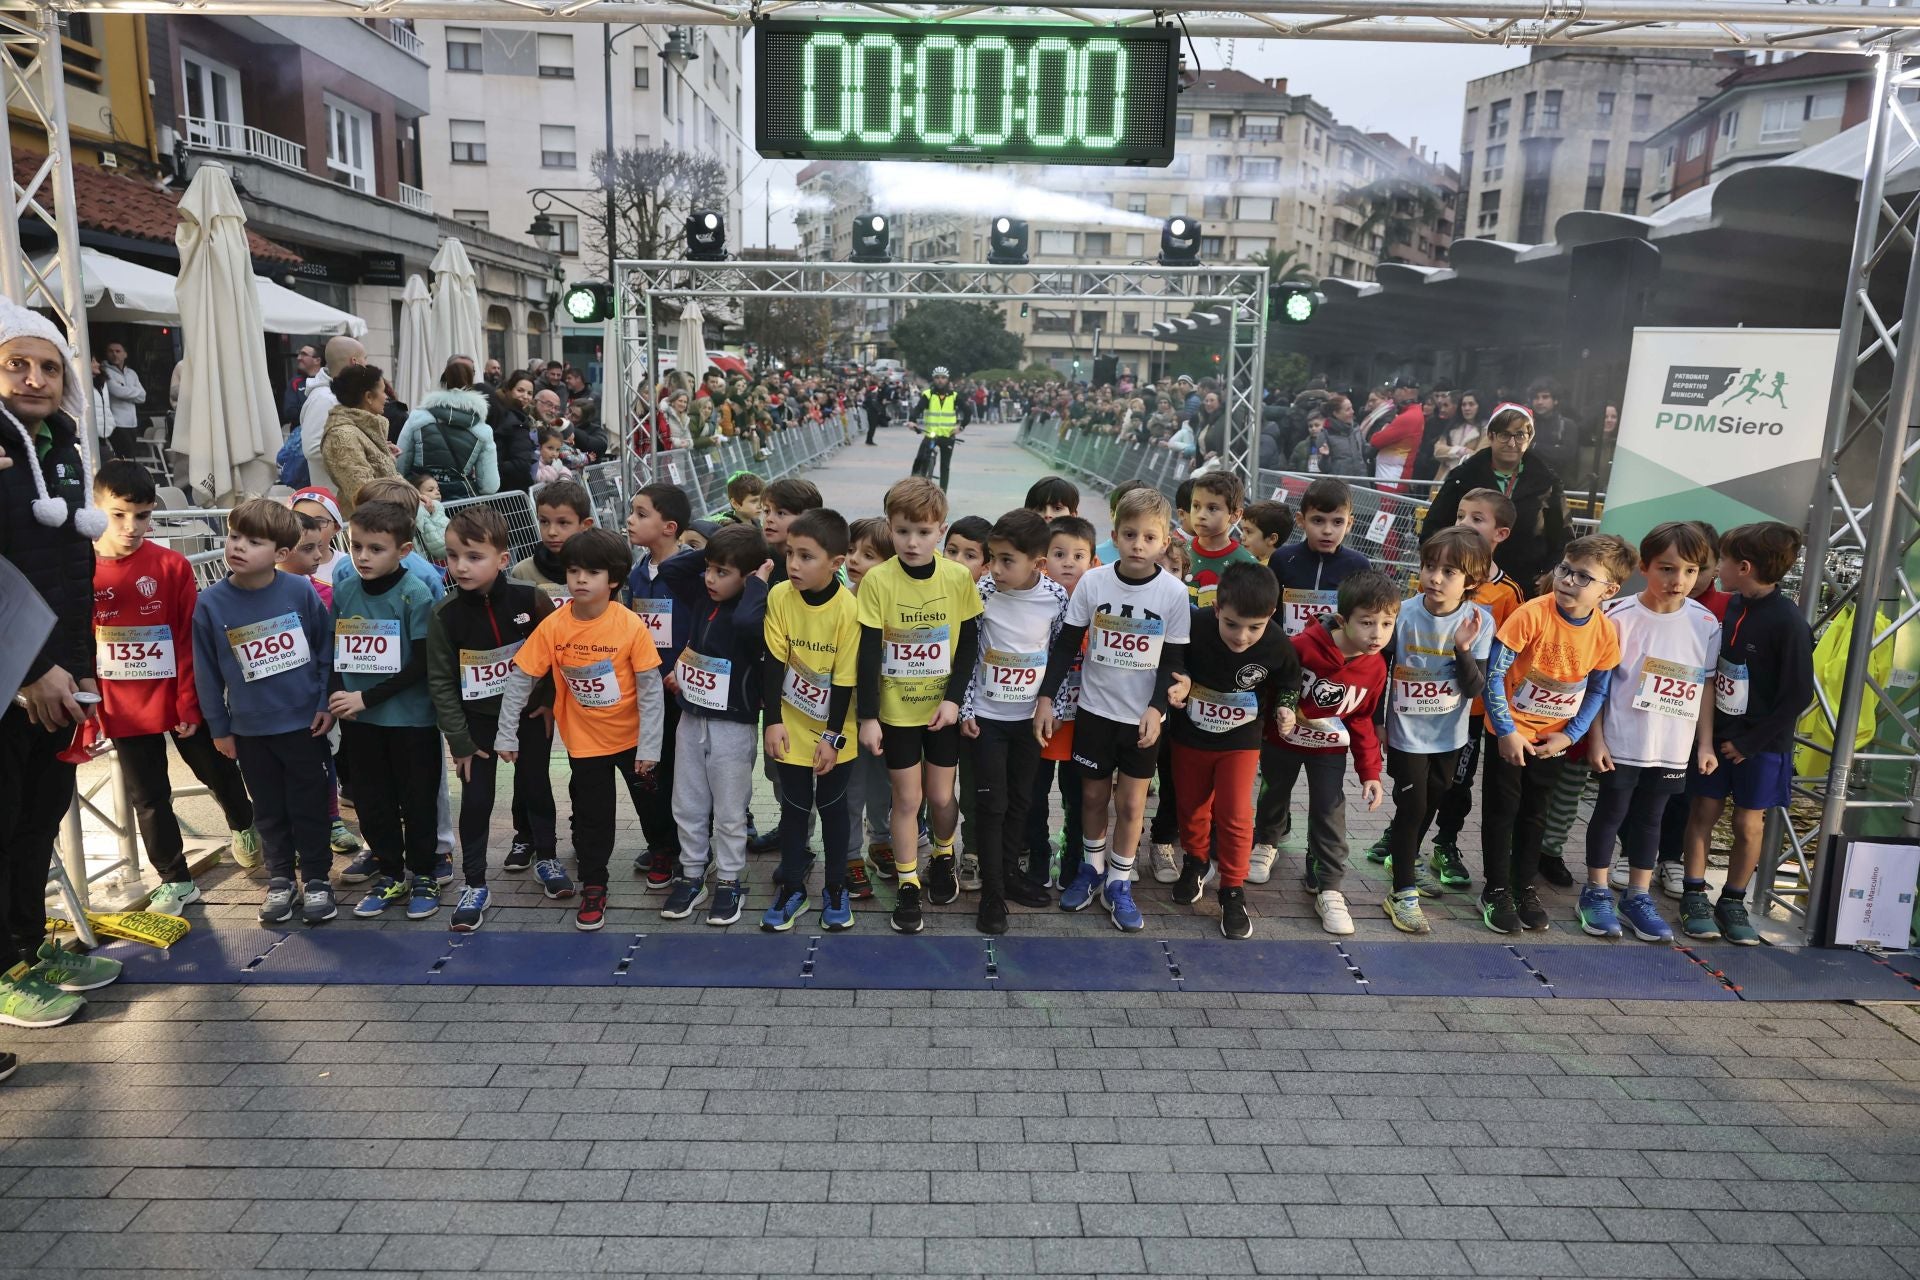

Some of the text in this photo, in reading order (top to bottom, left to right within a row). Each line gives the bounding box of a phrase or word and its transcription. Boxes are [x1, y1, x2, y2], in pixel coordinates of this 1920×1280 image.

[804, 32, 1126, 147] 00:00:00
[1670, 391, 1705, 399] MUNICIPAL
[1672, 382, 1707, 390] DEPORTIVO
[1655, 412, 1783, 436] PDMSiero
[637, 614, 662, 630] 34
[900, 611, 946, 623] Infiesto
[240, 632, 294, 661] 1260
[344, 635, 387, 654] 1270
[591, 644, 618, 653] Galbán
[1102, 630, 1150, 652] 1266
[106, 642, 164, 661] 1334
[249, 650, 296, 668] CARLOS BOS
[891, 643, 941, 661] 1340
[1115, 650, 1133, 659] LUCA
[265, 657, 305, 674] PDMSiero
[356, 663, 393, 671] PDMSiero
[906, 668, 944, 676] PDMSiero
[1113, 658, 1152, 668] PDMSiero
[124, 669, 169, 678] PDMSiero
[681, 663, 717, 690] 1253
[992, 665, 1037, 685] 1279
[687, 685, 706, 696] MATEO
[791, 673, 829, 705] 1321
[1402, 681, 1453, 698] 1284
[1652, 675, 1698, 701] 1236
[1715, 671, 1735, 695] 83
[688, 693, 720, 707] PDMSiero
[793, 692, 817, 709] MARCO
[1528, 684, 1577, 706] 1244
[1660, 696, 1684, 707] MATEO
[793, 700, 828, 720] PDMSiero
[1198, 700, 1246, 721] 1309
[1418, 703, 1456, 713] PDMSiero
[1534, 702, 1564, 711] CARLOS
[1659, 705, 1695, 718] PDMSiero
[1293, 723, 1340, 743] 1288
[1072, 751, 1098, 770] LEGEA
[1867, 866, 1879, 901] Masculino
[120, 918, 177, 943] ABRICADO
